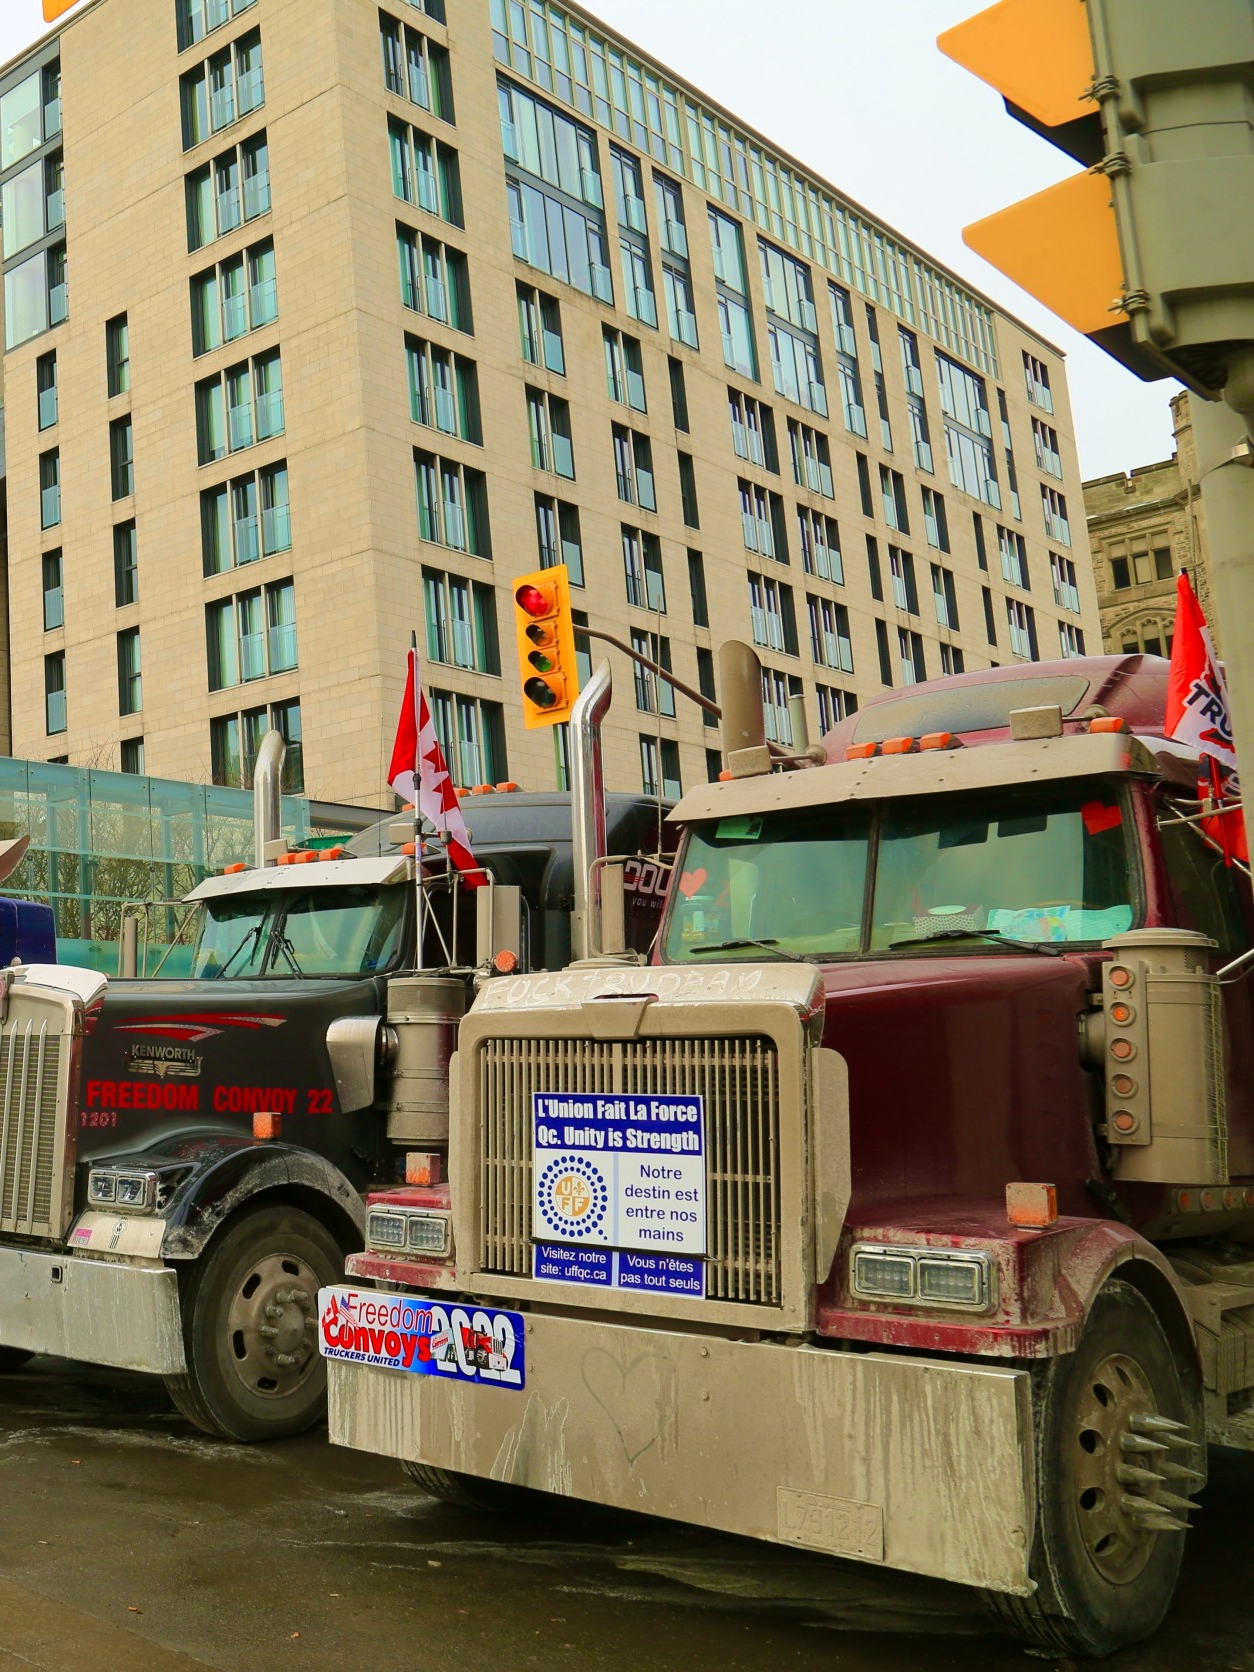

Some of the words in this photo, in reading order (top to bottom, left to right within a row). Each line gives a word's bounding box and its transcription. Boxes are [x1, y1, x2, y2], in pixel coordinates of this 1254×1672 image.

[131, 1044, 195, 1060] KENWORTH
[86, 1080, 199, 1111] FREEDOM
[213, 1086, 298, 1114] CONVOY
[307, 1089, 333, 1114] 22
[537, 1099, 594, 1119] L'Union
[596, 1100, 626, 1120] Fait
[629, 1101, 647, 1121] La
[650, 1102, 698, 1122] Force
[538, 1125, 562, 1146] Qc.
[564, 1126, 605, 1149] Unity
[608, 1128, 623, 1147] is
[626, 1128, 700, 1152] Strength
[640, 1164, 682, 1180] Notre
[625, 1184, 671, 1200] destin
[675, 1188, 699, 1202] est
[626, 1206, 666, 1220] entre
[670, 1211, 698, 1222] nos
[639, 1227, 684, 1242] mains
[542, 1246, 576, 1261] Visitez
[578, 1250, 607, 1264] notre
[627, 1255, 656, 1269] Vous
[659, 1257, 694, 1272] n'êtes
[541, 1263, 562, 1275] site:
[565, 1265, 607, 1281] uffqc.ca
[620, 1273, 641, 1284] pas
[644, 1274, 666, 1287] tout
[669, 1277, 700, 1290] seuls
[347, 1293, 433, 1334] Freedom
[323, 1322, 433, 1368] Convoys
[429, 1305, 522, 1385] 2022
[324, 1347, 366, 1361] TRUCKERS
[367, 1354, 400, 1367] UNITED
